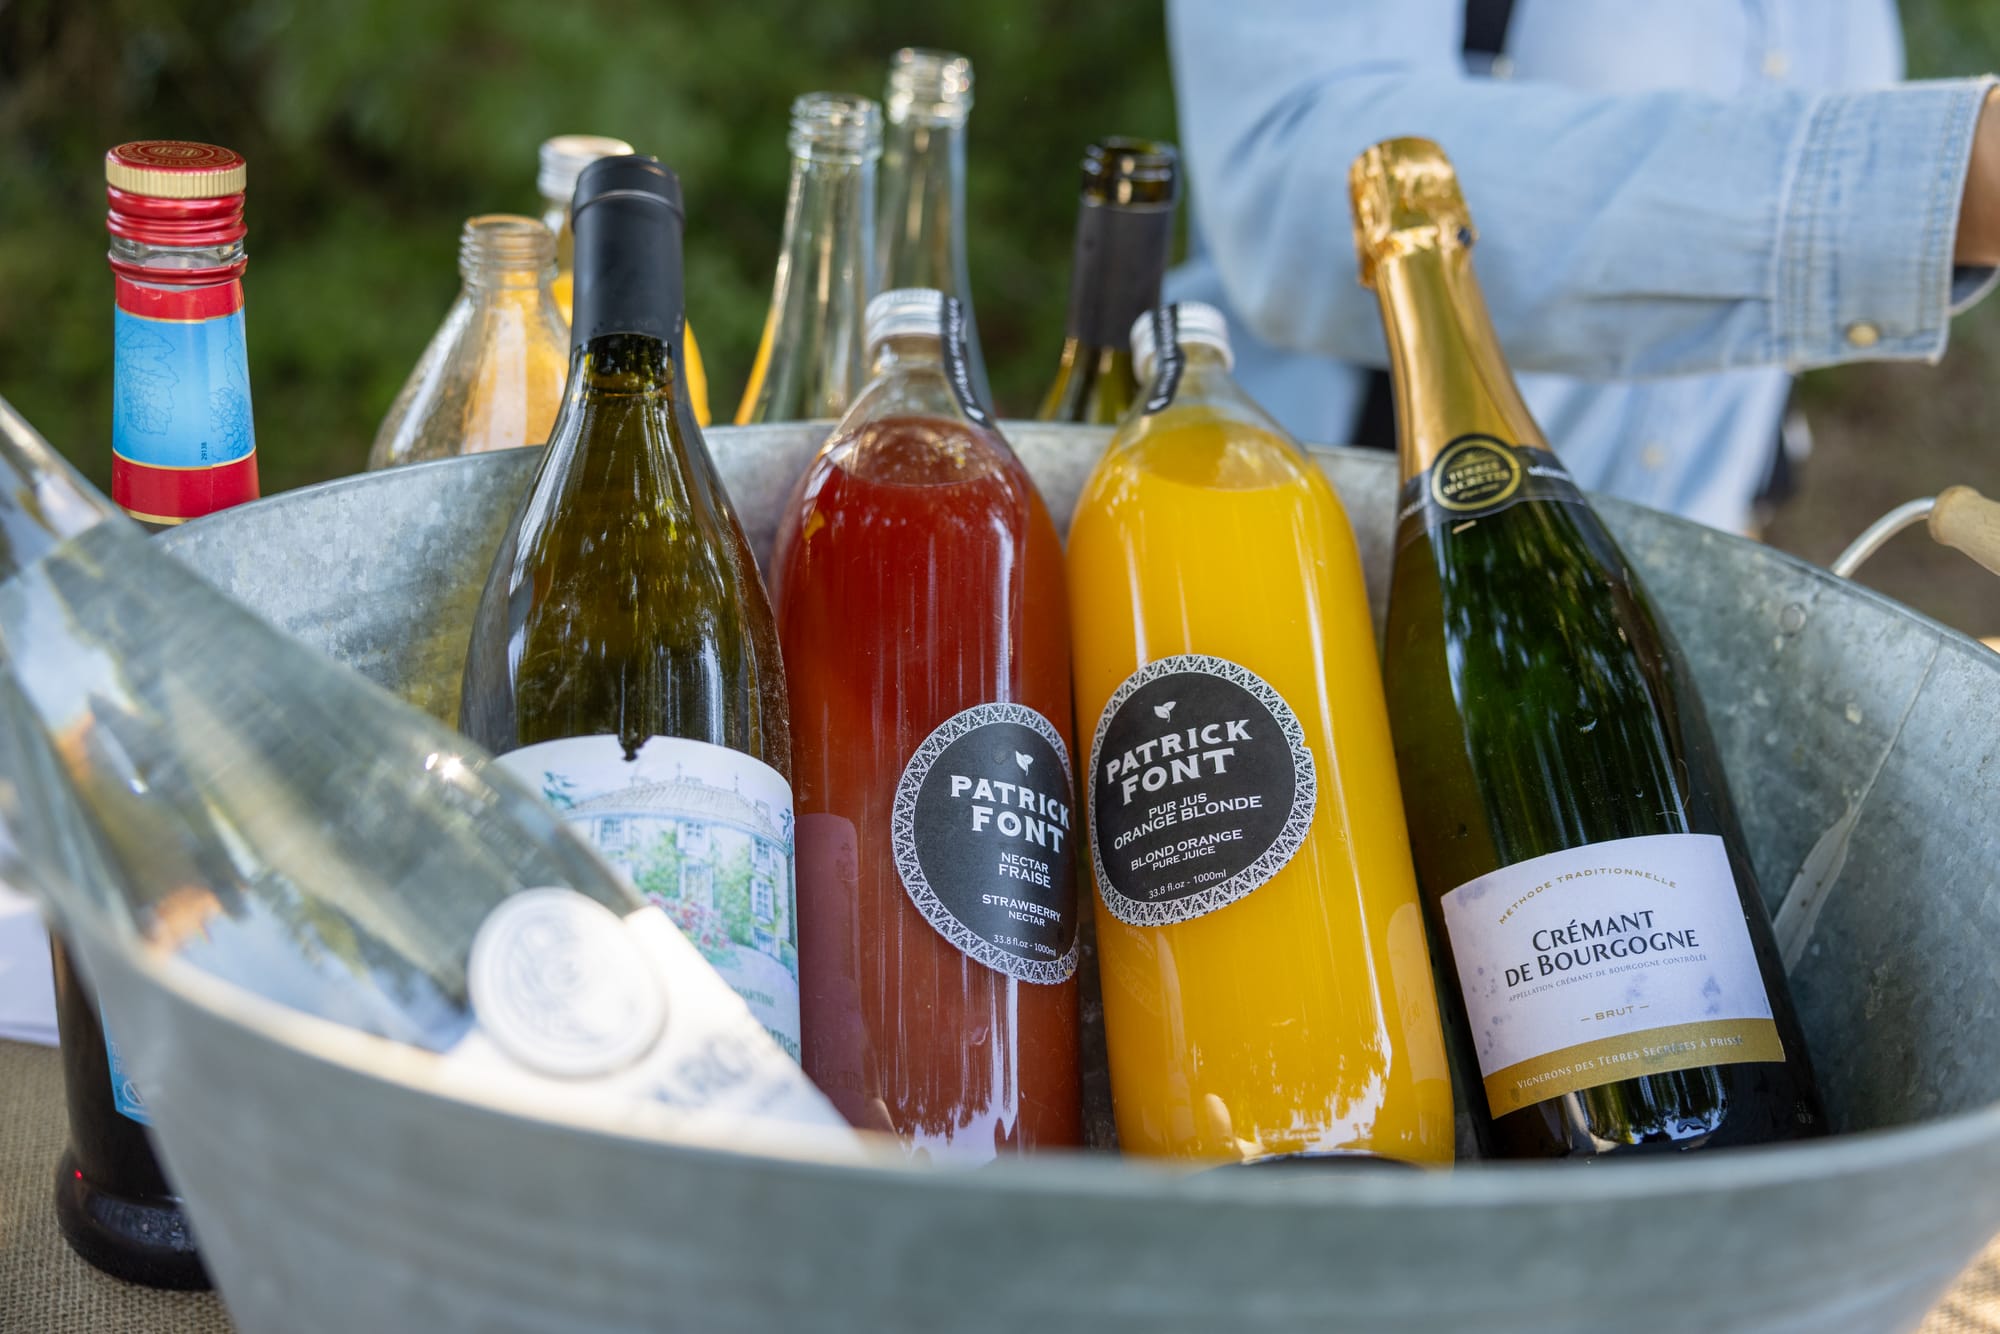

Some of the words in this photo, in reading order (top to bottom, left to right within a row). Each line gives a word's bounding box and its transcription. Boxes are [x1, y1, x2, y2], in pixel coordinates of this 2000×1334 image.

[1105, 718, 1253, 785] PATRICK
[1120, 747, 1235, 807] FONT
[950, 775, 1071, 831] PATRICK
[1148, 800, 1177, 819] PUR
[1179, 792, 1208, 809] JUS
[971, 804, 1065, 854] FONT
[1113, 812, 1178, 851] ORANGE
[1181, 795, 1263, 822] BLONDE
[1001, 851, 1049, 875] NECTAR
[1130, 845, 1175, 872] BLOND
[1176, 828, 1244, 852] ORANGE
[1152, 854, 1181, 871] PURE
[1182, 845, 1216, 862] JUICE
[998, 863, 1052, 889] FRAISE
[1148, 888, 1166, 900] 33.8
[1167, 881, 1185, 893] fl.oz
[1193, 869, 1227, 885] 1000ml
[1556, 868, 1677, 889] TRADITIONNELLE
[982, 893, 1062, 922] STRAWBERRY
[1008, 910, 1046, 927] NECTAR
[993, 934, 1012, 945] 33.8
[1012, 937, 1029, 949] fl.oz
[1034, 942, 1057, 957] 1000ml
[1532, 909, 1654, 952] CRÉMANT
[1505, 962, 1534, 988] DE
[1537, 929, 1700, 977] BOURGOGNE
[1555, 971, 1594, 988] CRÉMANT
[1595, 970, 1607, 978] DE
[1609, 959, 1661, 977] BOURGOGNE
[1595, 1005, 1634, 1021] BRUT
[1516, 1065, 1572, 1089] VIGNERONS
[1575, 1060, 1595, 1073] DES
[1597, 1050, 1640, 1067] TERRES
